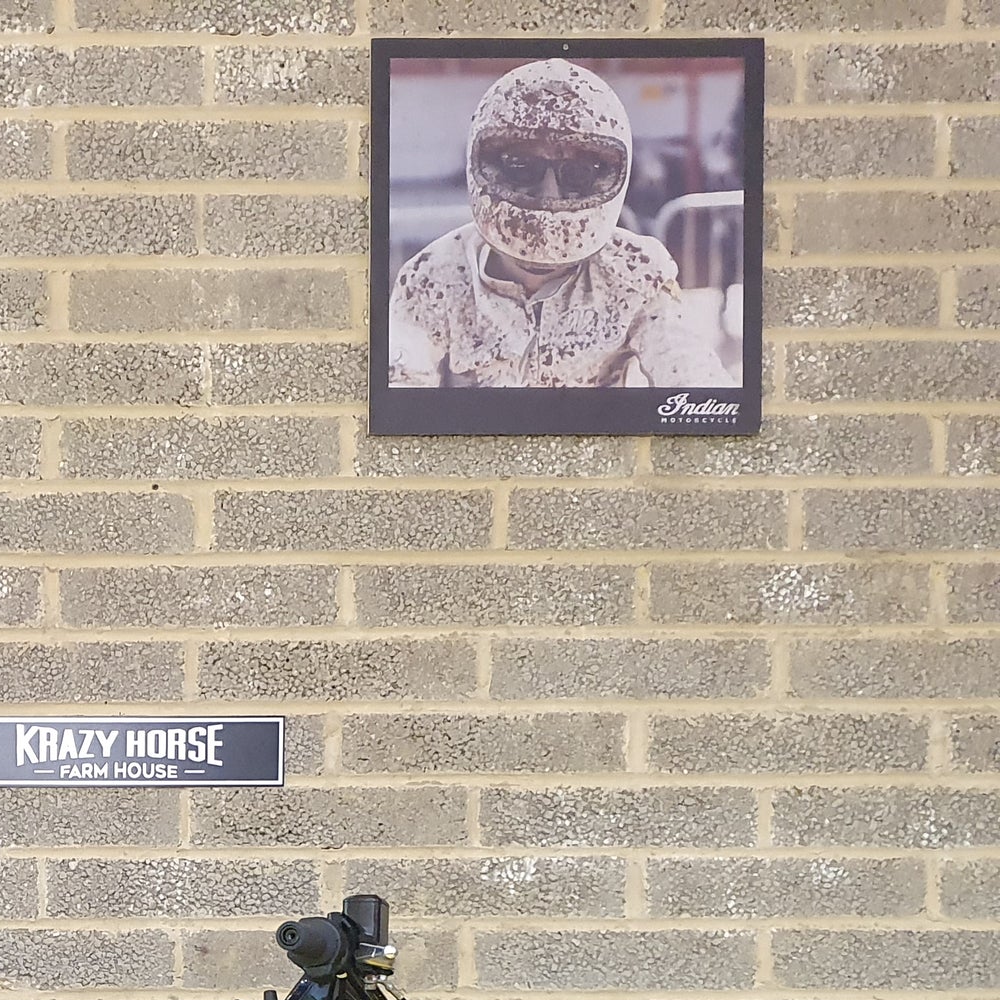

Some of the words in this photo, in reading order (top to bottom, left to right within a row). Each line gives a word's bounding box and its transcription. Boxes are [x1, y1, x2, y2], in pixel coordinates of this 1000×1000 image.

[657, 392, 740, 416] Indian
[16, 724, 119, 767] KRAZY
[126, 724, 223, 767] HORSE
[60, 763, 109, 779] FARM
[113, 763, 178, 779] HOUSE
